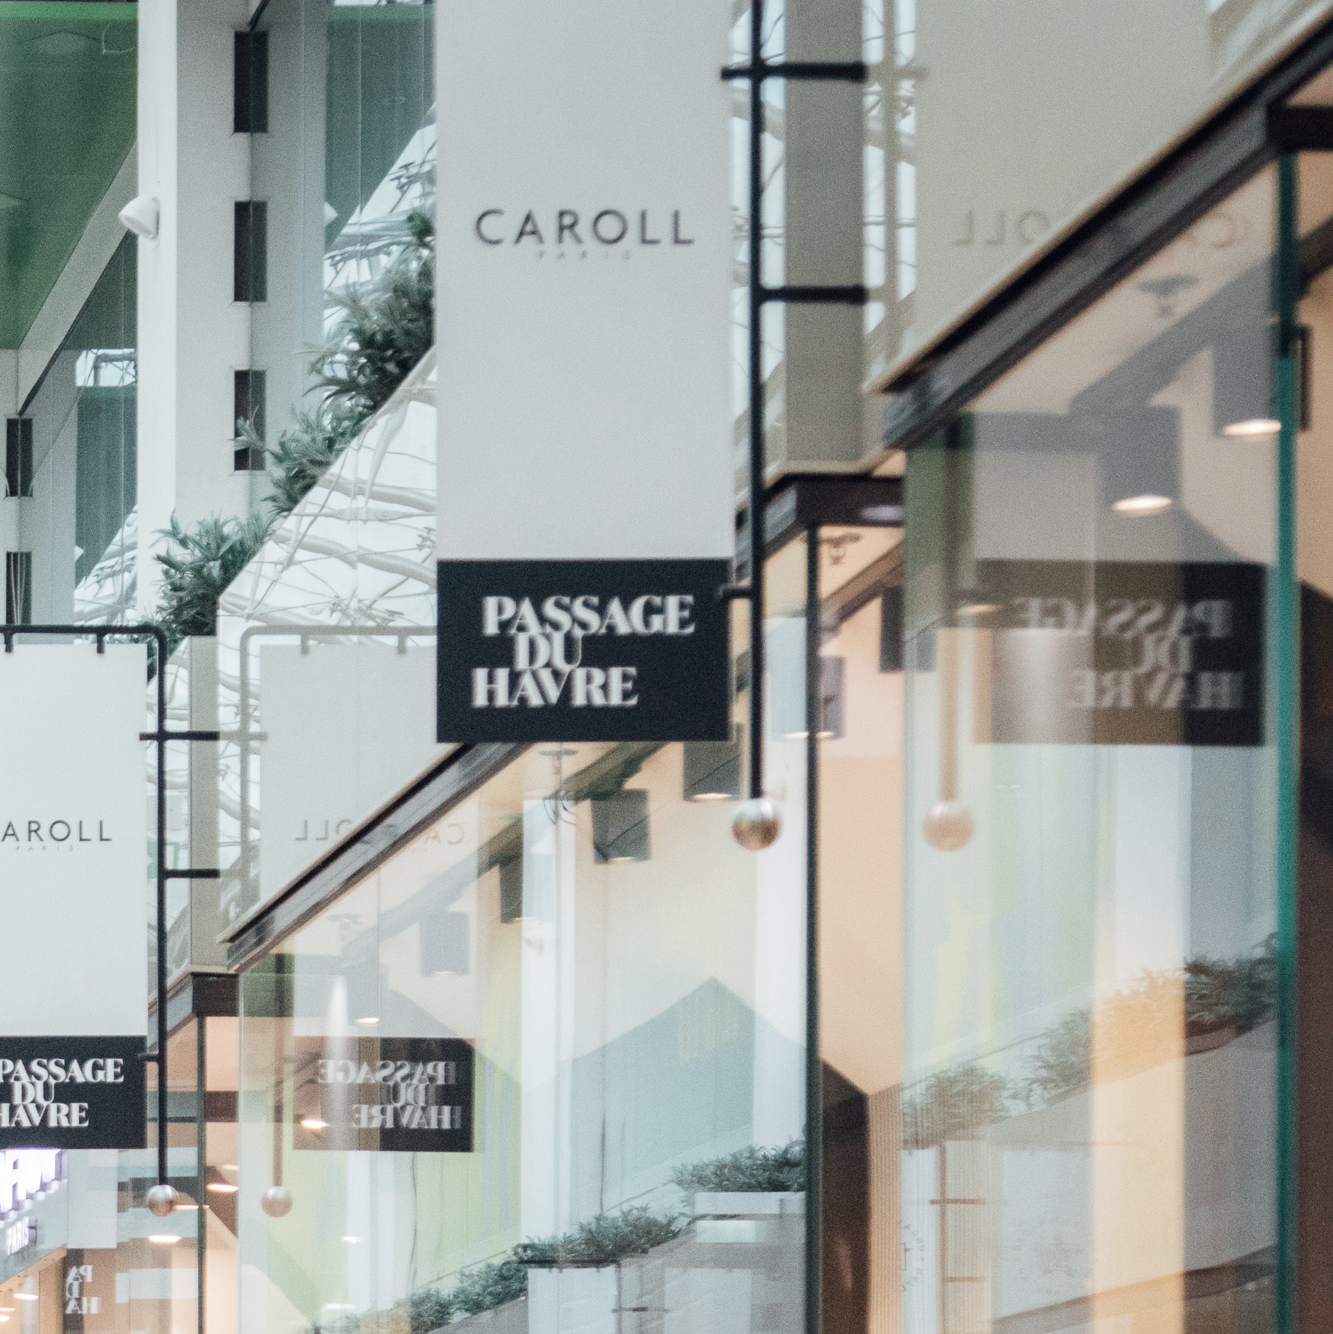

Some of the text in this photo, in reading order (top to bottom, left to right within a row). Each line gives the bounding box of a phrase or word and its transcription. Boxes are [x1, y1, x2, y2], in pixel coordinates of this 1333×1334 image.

[474, 208, 695, 247] CAROLL
[484, 596, 694, 638] PASSAGE
[515, 632, 581, 673] DU
[473, 667, 637, 707] HAVRE
[13, 1081, 54, 1106] DU
